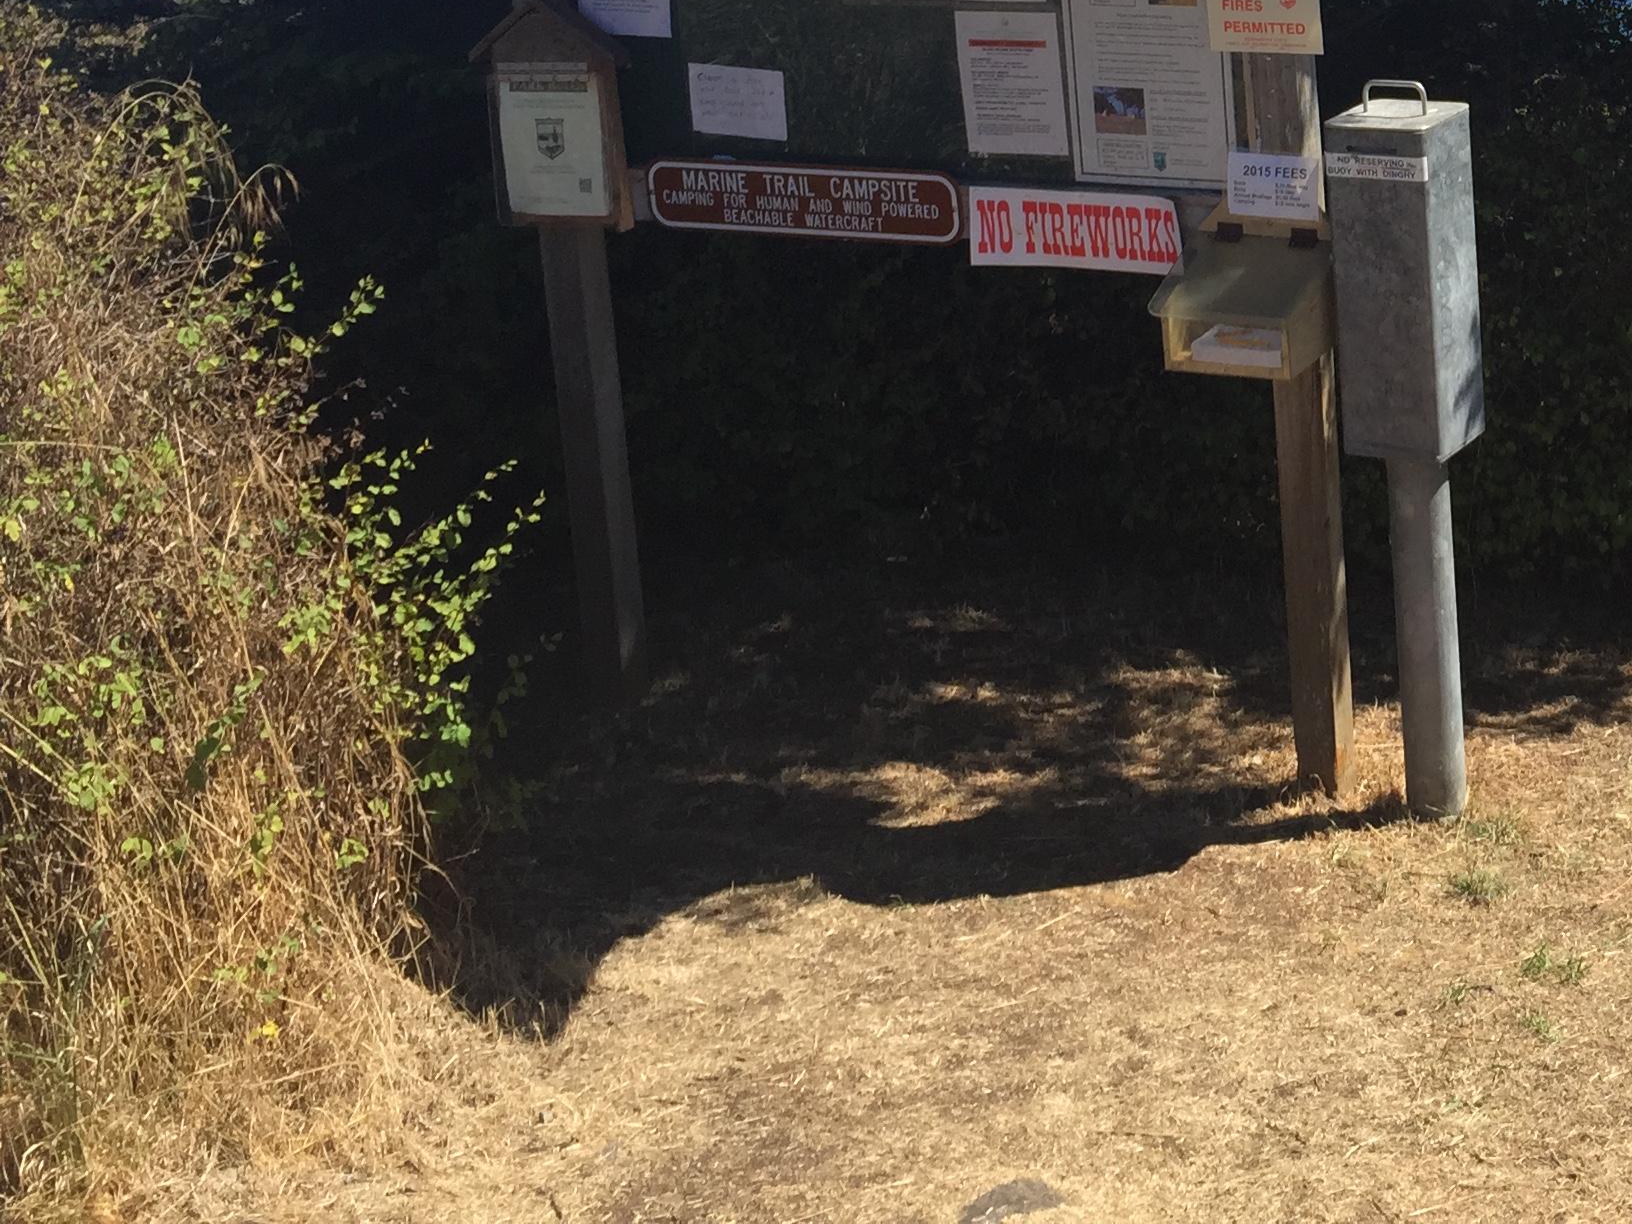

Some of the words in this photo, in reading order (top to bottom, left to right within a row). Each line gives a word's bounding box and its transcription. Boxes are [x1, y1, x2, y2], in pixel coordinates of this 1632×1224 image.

[1221, 0, 1263, 12] FIRES
[1224, 21, 1306, 35] PERMITTED
[1336, 156, 1350, 164] NO
[1354, 157, 1404, 168] RESERVING
[1243, 165, 1271, 178] 2015
[1275, 167, 1307, 179] FEES
[1328, 166, 1352, 175] BUOY
[1356, 168, 1378, 176] WITH
[1382, 170, 1416, 179] DINGHY
[682, 170, 749, 194] MARINE
[763, 174, 815, 197] TRAIL
[830, 177, 920, 203] CAMPSITE
[663, 189, 715, 207] CAMPING
[723, 194, 747, 209] FOR
[756, 196, 799, 212] HUMAN
[808, 198, 833, 213] AND
[843, 200, 872, 215] WIND
[881, 202, 939, 220] POWERED
[724, 209, 795, 227] BEACHABLE
[804, 214, 884, 232] WATERCRAFT
[976, 200, 1013, 254] NO
[1022, 201, 1178, 264] FIREWORKS
